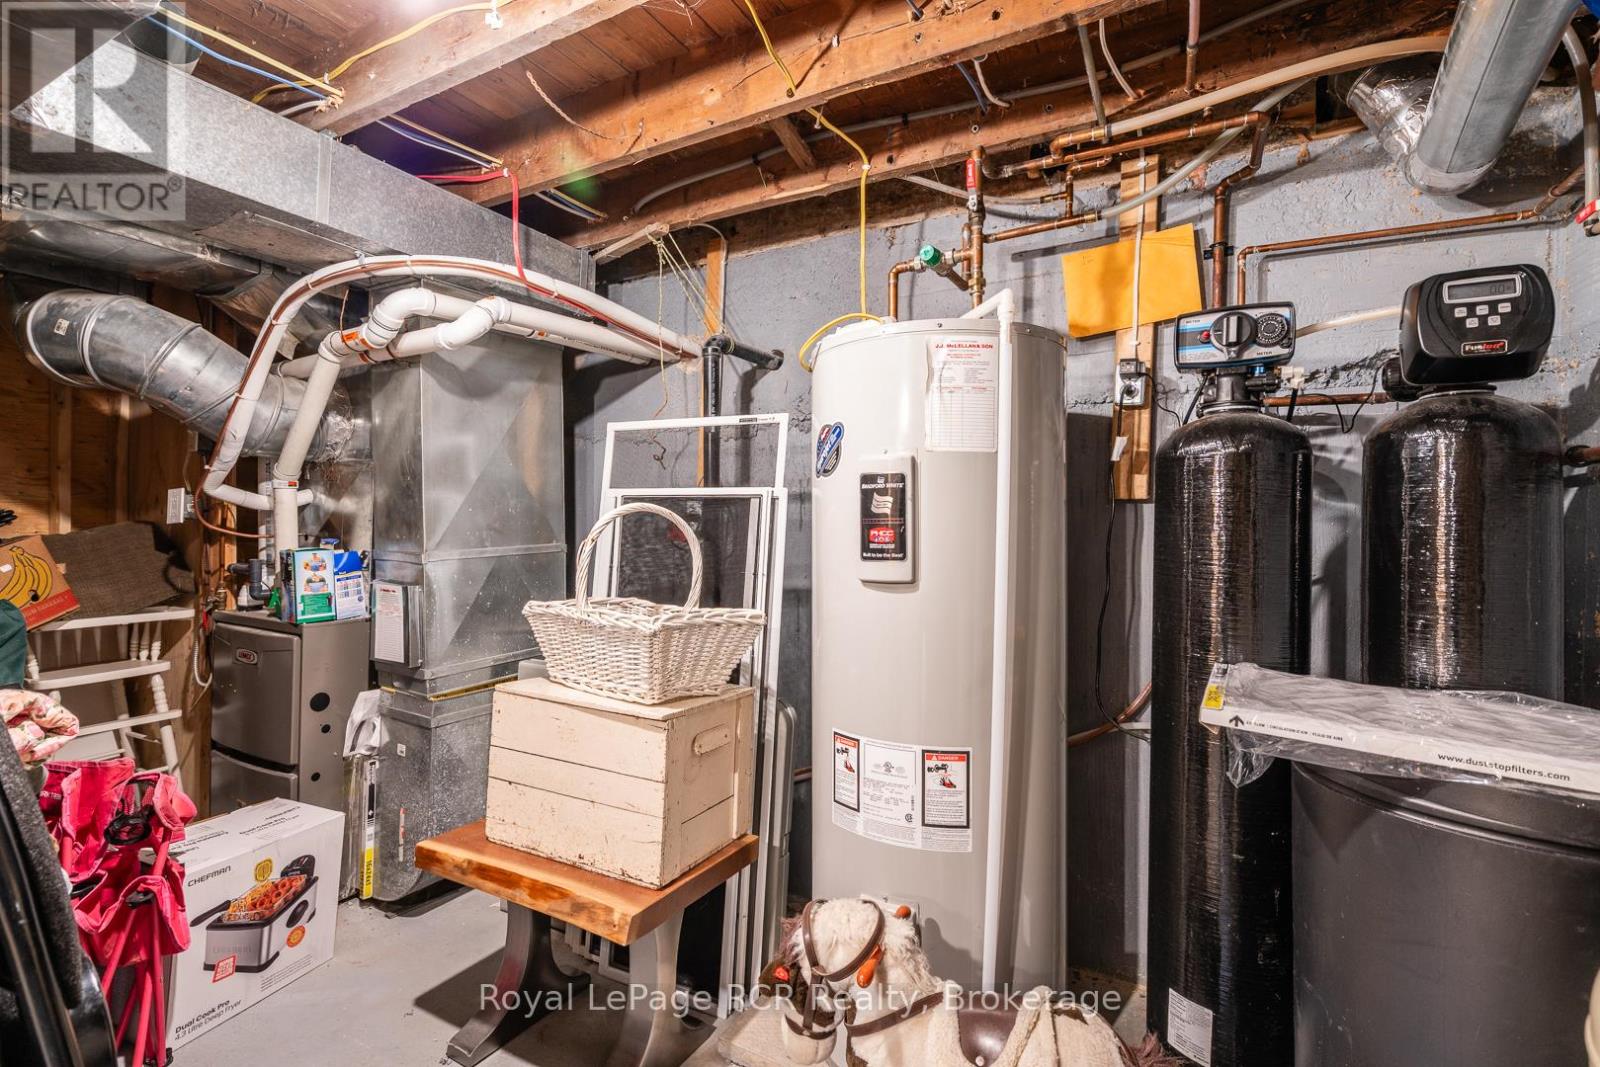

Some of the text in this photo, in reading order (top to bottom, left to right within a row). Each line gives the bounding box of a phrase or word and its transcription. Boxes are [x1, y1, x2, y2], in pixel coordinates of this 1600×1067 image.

[187, 865, 232, 887] CHEFMAN
[175, 999, 230, 1034] Dual Cook Pro
[175, 1030, 187, 1041] 4.3
[204, 1010, 224, 1028] Deep
[224, 1000, 242, 1017] Fryer
